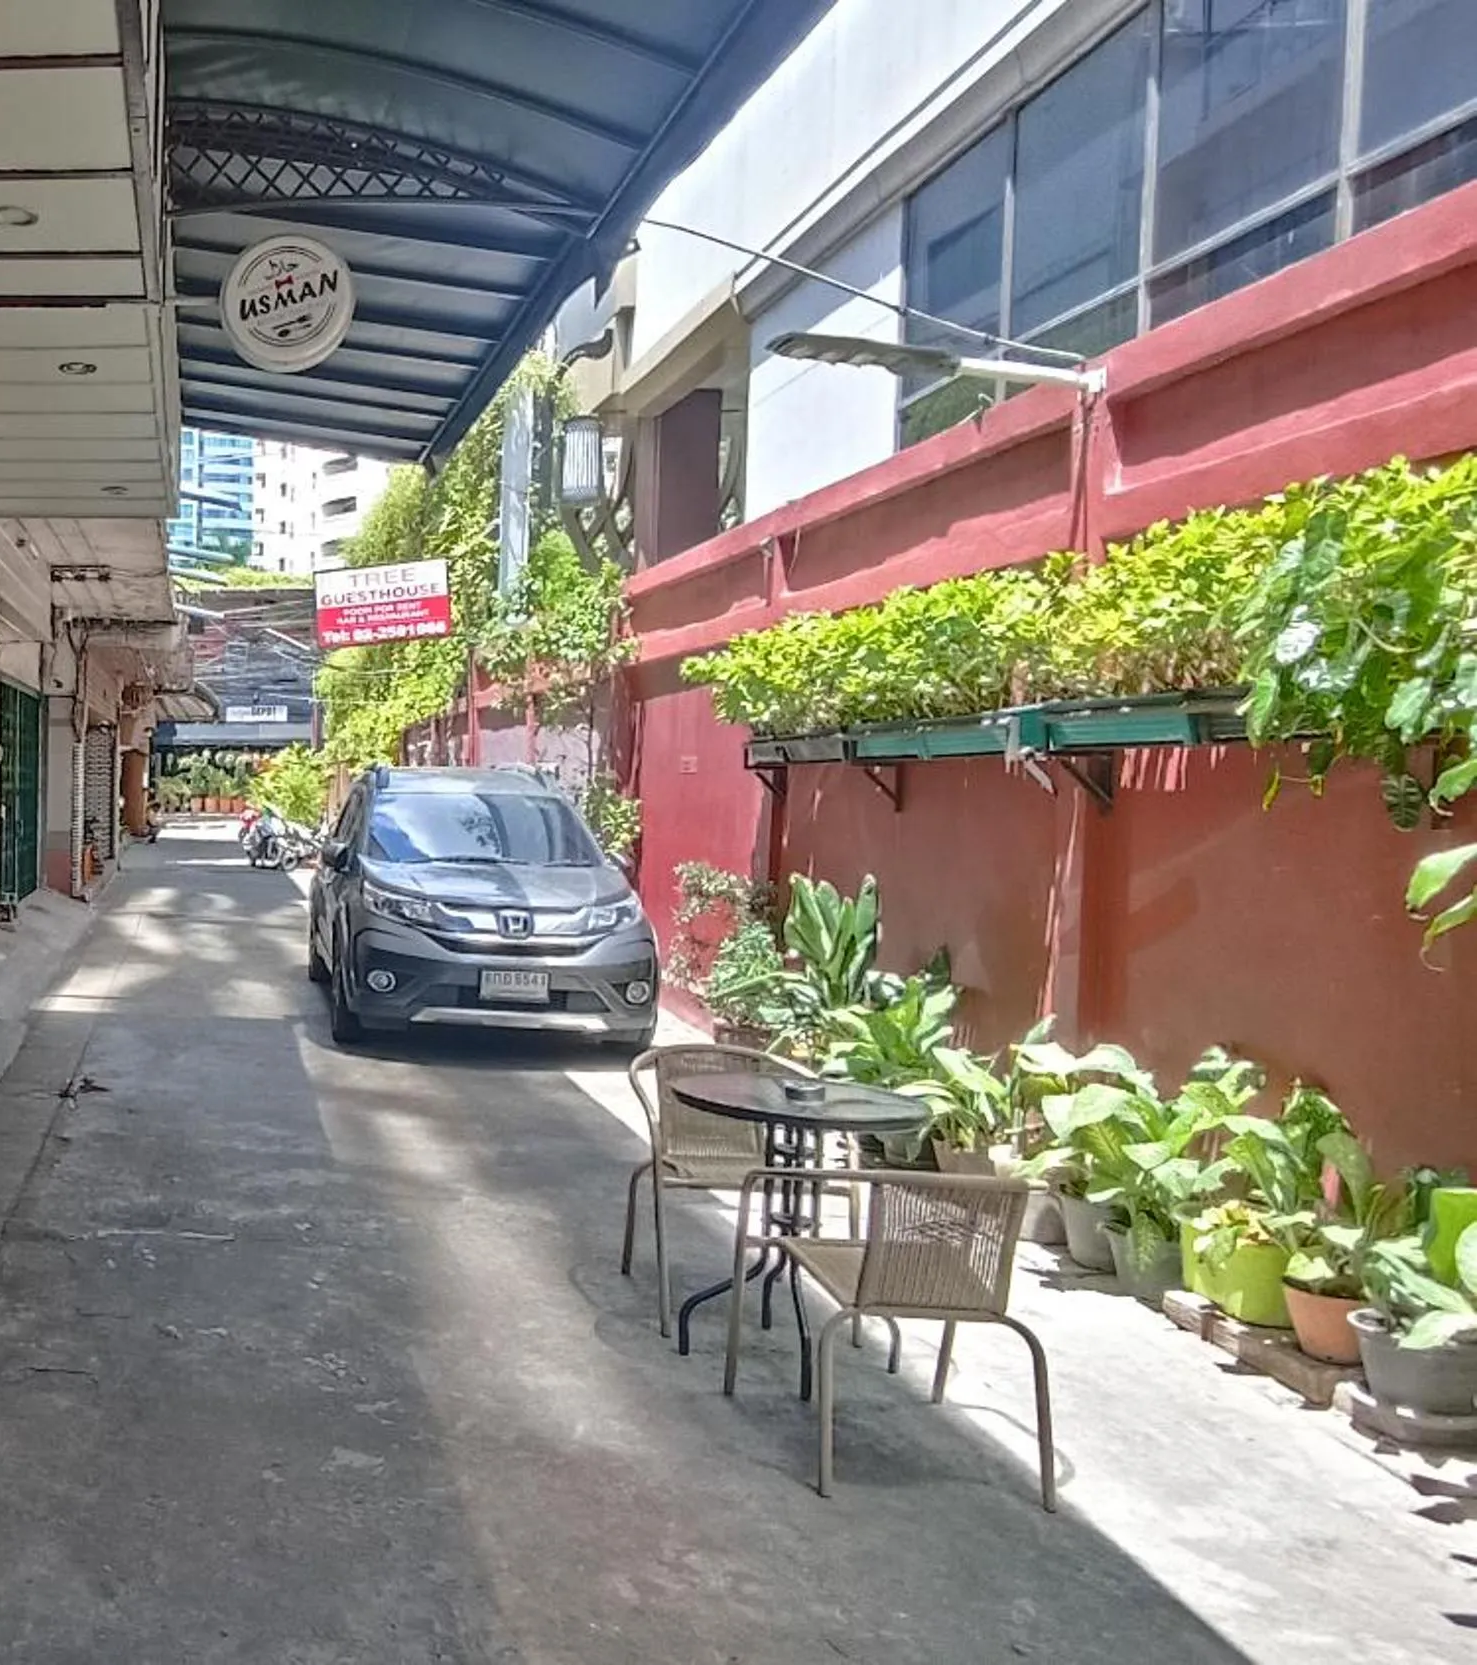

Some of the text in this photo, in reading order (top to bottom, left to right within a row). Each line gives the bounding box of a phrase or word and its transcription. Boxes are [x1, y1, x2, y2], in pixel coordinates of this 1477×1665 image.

[239, 269, 339, 321] USMAN
[348, 567, 416, 587] TREE
[319, 582, 441, 606] GUESTHOUSE
